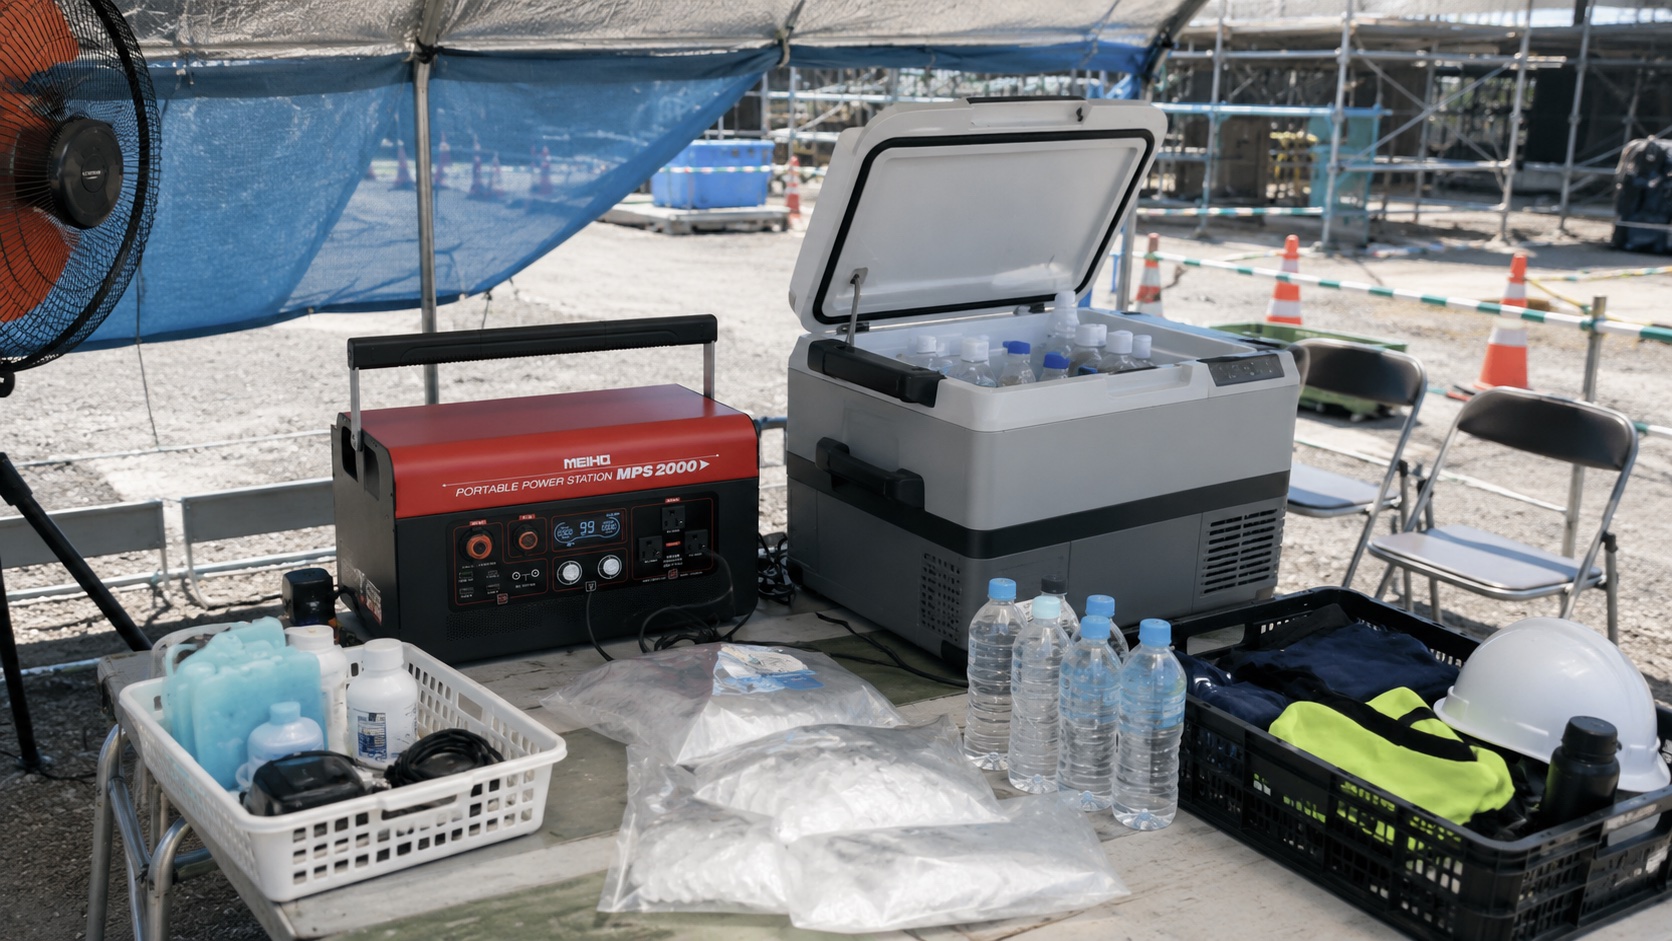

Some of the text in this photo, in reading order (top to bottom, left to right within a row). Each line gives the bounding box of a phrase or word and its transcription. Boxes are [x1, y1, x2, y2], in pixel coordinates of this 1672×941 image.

[455, 460, 698, 497] PORTABLE POWER STATION MPS 2000
[580, 521, 595, 536] 99
